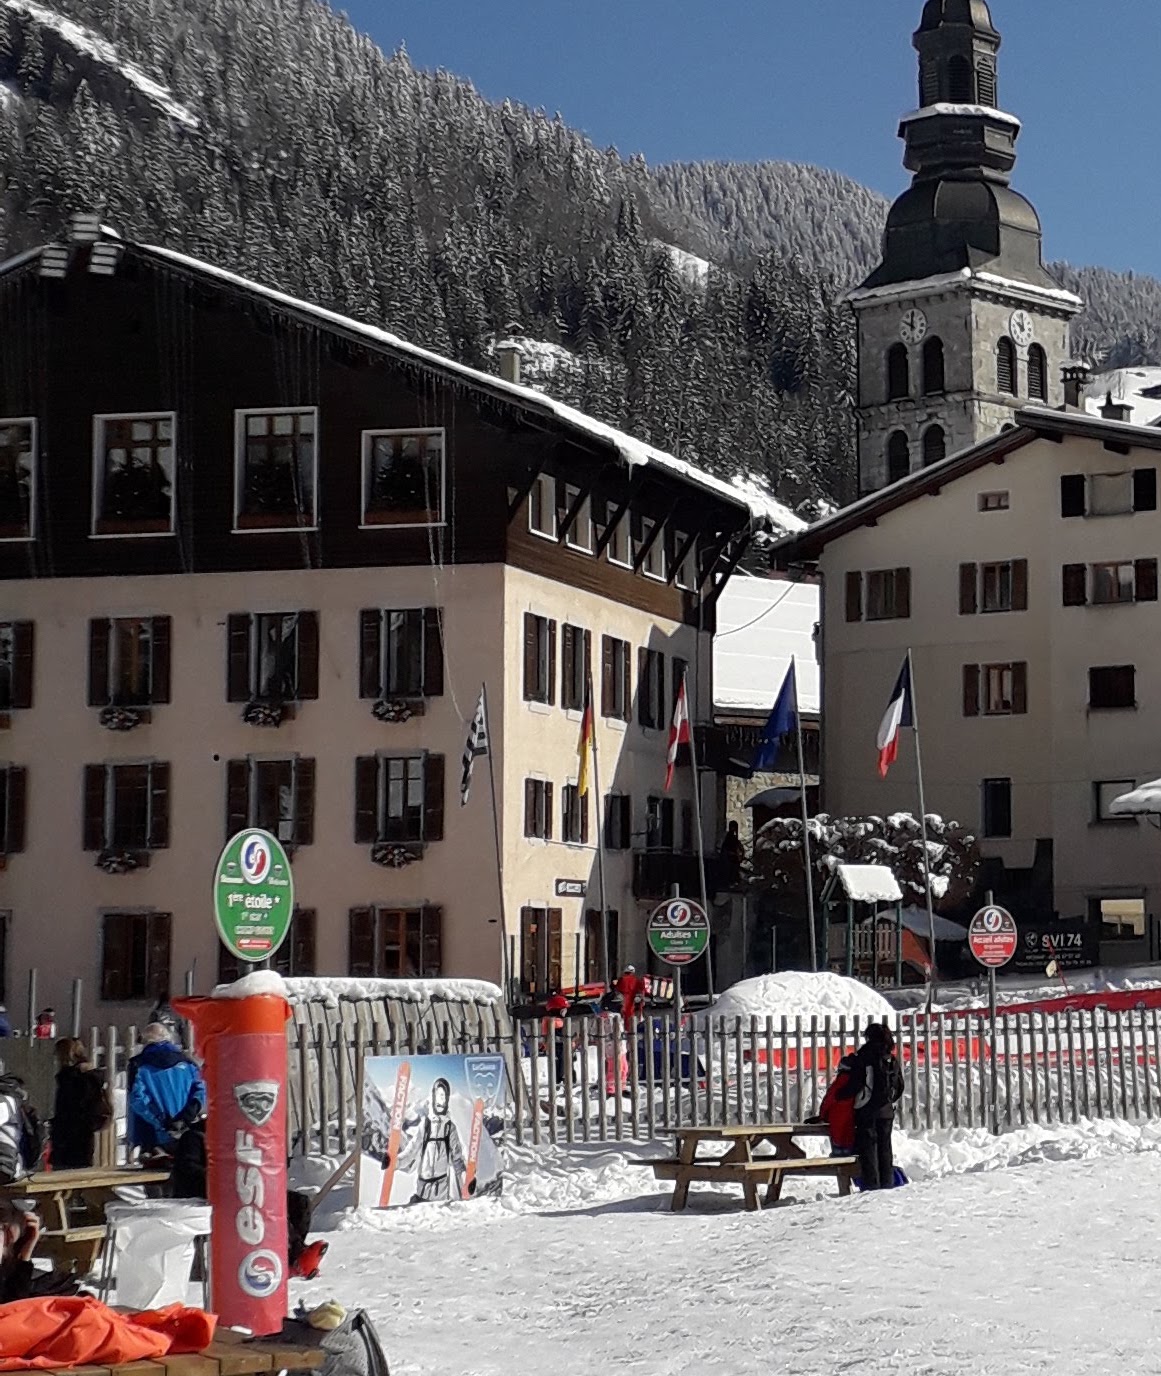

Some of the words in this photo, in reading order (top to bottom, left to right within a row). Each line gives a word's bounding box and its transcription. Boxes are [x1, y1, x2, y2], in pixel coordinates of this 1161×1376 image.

[1042, 934, 1064, 947] SVI
[1067, 934, 1082, 946] 74
[393, 1076, 408, 1130] FACTION
